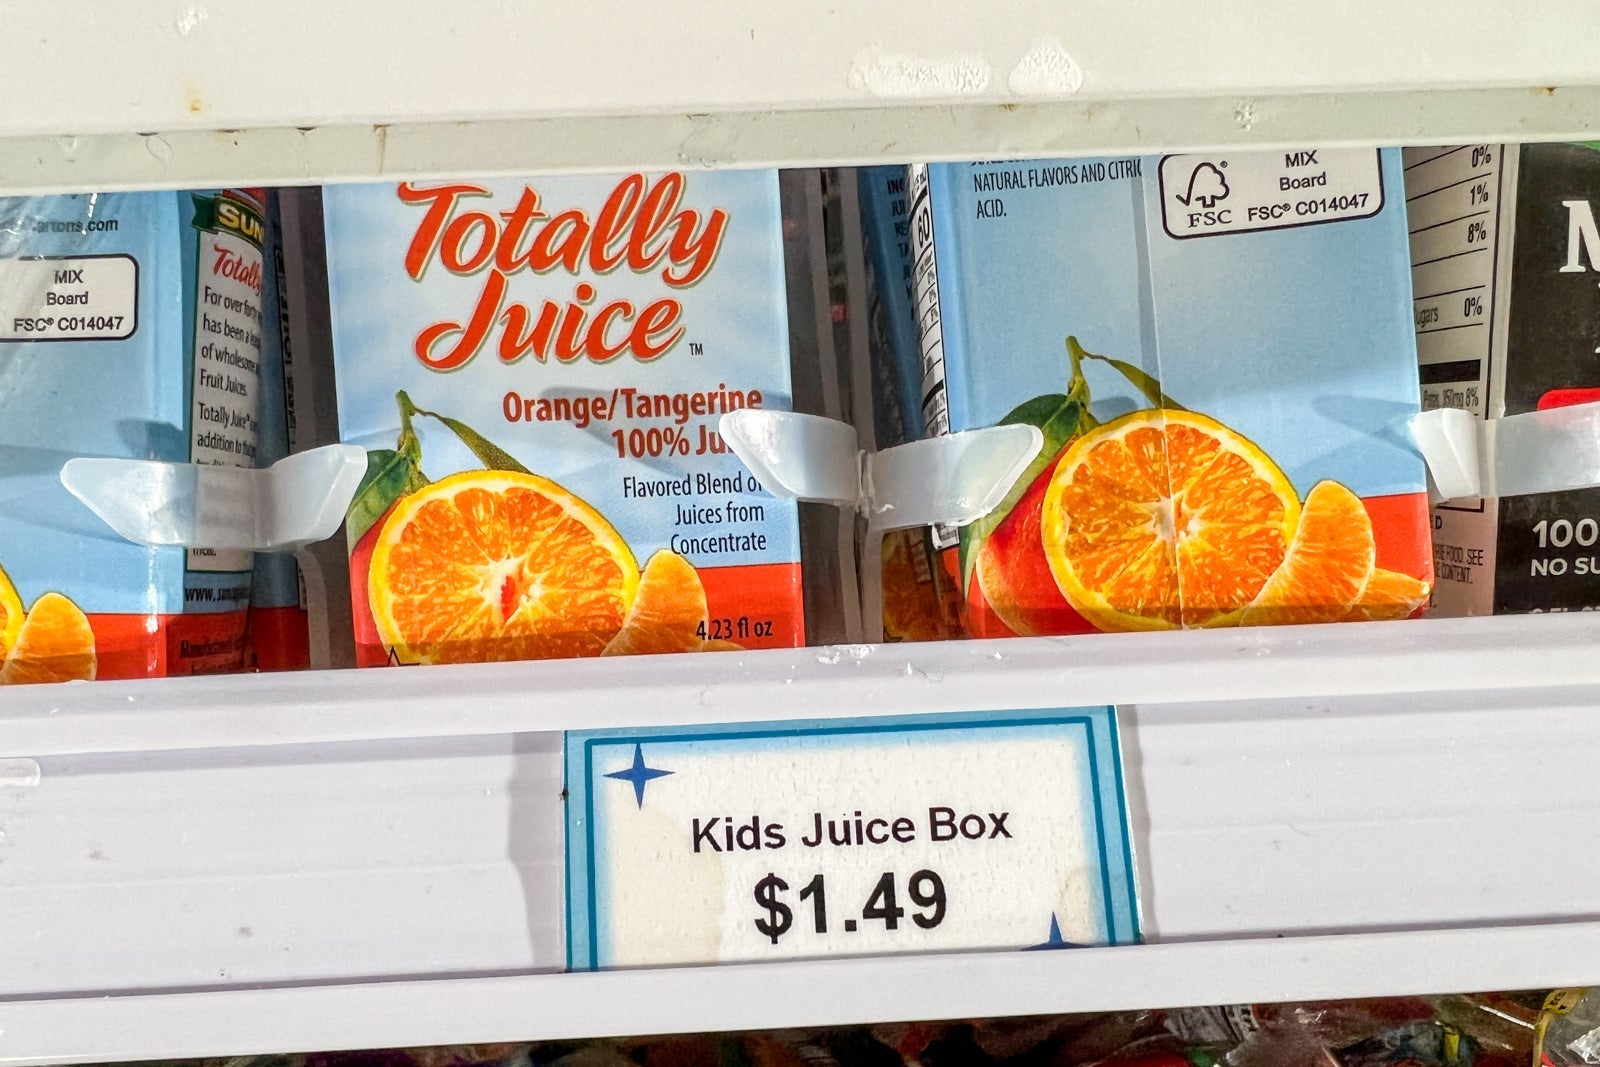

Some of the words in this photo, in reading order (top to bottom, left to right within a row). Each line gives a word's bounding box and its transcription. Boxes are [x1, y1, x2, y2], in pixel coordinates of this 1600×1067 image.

[1285, 149, 1319, 168] MIX
[1472, 144, 1491, 168] 0%
[974, 172, 1027, 193] NATURAL
[1028, 165, 1079, 188] FLAVORS
[1081, 162, 1106, 184] AND
[1279, 172, 1327, 191] Board
[1295, 193, 1369, 216] C014047
[1470, 182, 1489, 206] 1%
[976, 198, 1007, 219] ACID.
[1187, 209, 1232, 228] FSC
[32, 219, 119, 234] artons.com
[398, 170, 731, 288] Totally
[1467, 220, 1486, 243] 8%
[54, 269, 84, 284] MIX
[213, 243, 262, 297] Totally
[46, 291, 89, 306] Board
[204, 285, 222, 304] For
[223, 296, 244, 313] over
[1464, 295, 1482, 317] 0%
[57, 316, 125, 332] C014047
[203, 312, 222, 335] has
[224, 317, 246, 343] been
[413, 268, 686, 374] Juice
[201, 342, 214, 361] of
[200, 368, 223, 390] Fruit
[502, 383, 763, 429] Orange/Tangerine
[1465, 386, 1479, 407] 8%
[198, 401, 230, 429] Totally
[197, 431, 234, 454] addition
[611, 426, 690, 459] 100%
[623, 473, 691, 498] Flavored
[696, 470, 742, 494] Blend
[675, 503, 722, 526] Juices
[726, 501, 765, 523] from
[670, 532, 767, 555] Concentrate
[1467, 548, 1484, 566] SEE
[1530, 558, 1568, 577] NO
[696, 618, 733, 640] 4.23
[737, 616, 749, 638] fl
[753, 620, 773, 637] oz
[692, 815, 786, 853] Kids
[800, 810, 915, 847] Juice
[929, 806, 1013, 842] Box
[754, 868, 947, 945] $1.49
